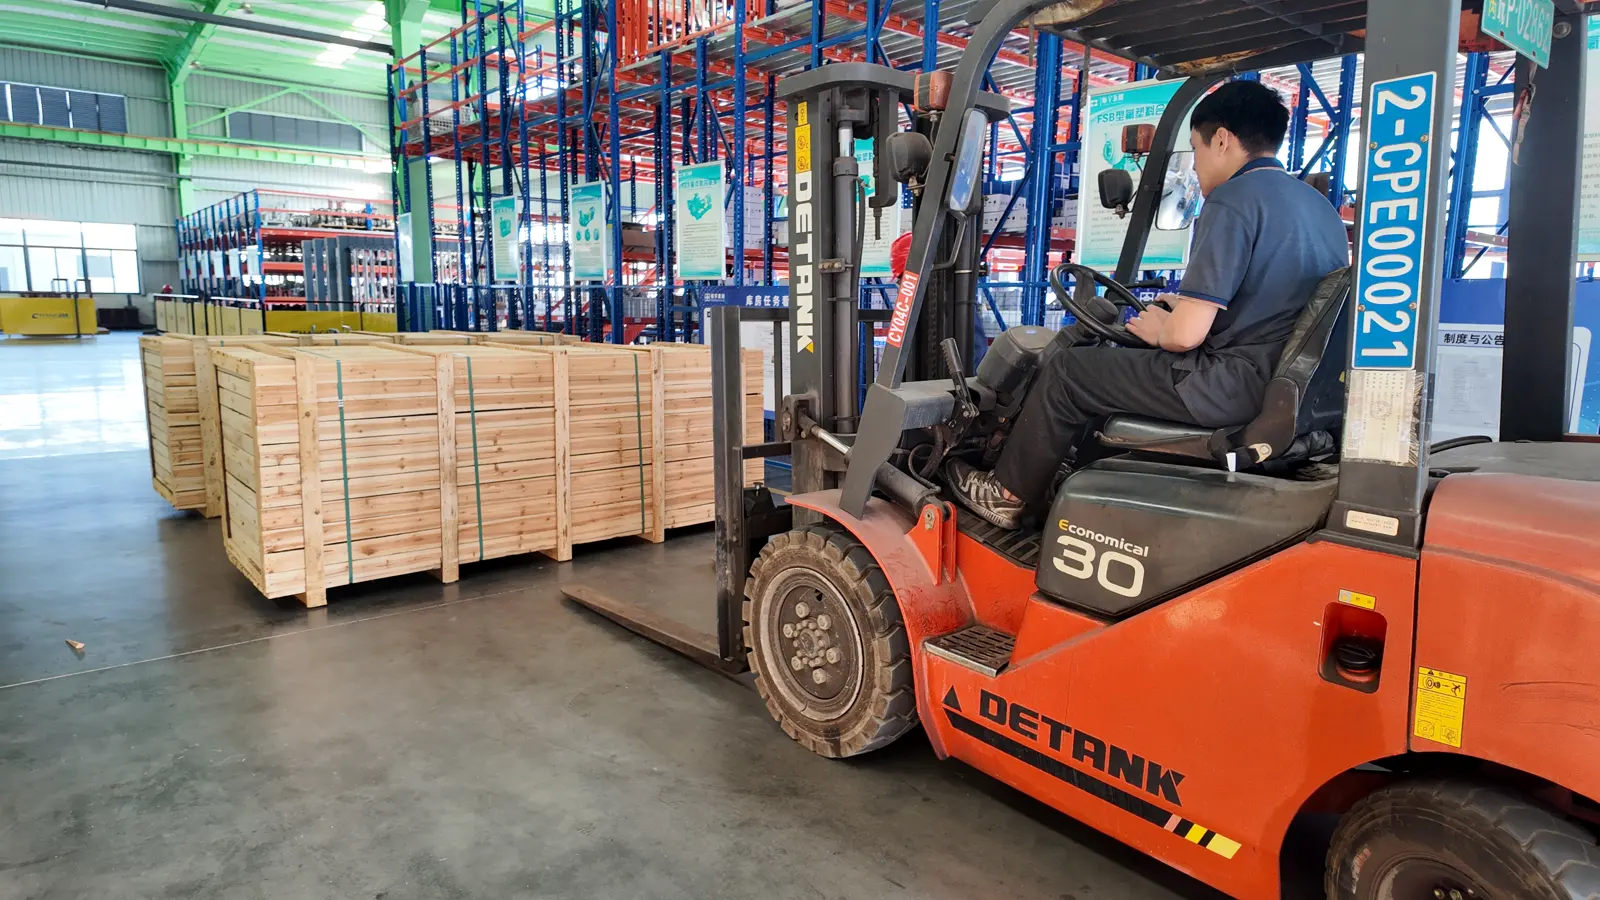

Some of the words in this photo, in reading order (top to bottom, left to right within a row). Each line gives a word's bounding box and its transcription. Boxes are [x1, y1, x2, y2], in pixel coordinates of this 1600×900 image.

[1361, 85, 1426, 357] 2-CPE00021
[795, 171, 814, 353] DETANK
[888, 274, 918, 343] CY04C-001
[1443, 332, 1505, 346] 制度与公告
[1052, 535, 1145, 598] 30
[1058, 518, 1150, 558] Economical
[979, 688, 1186, 808] DETANK
